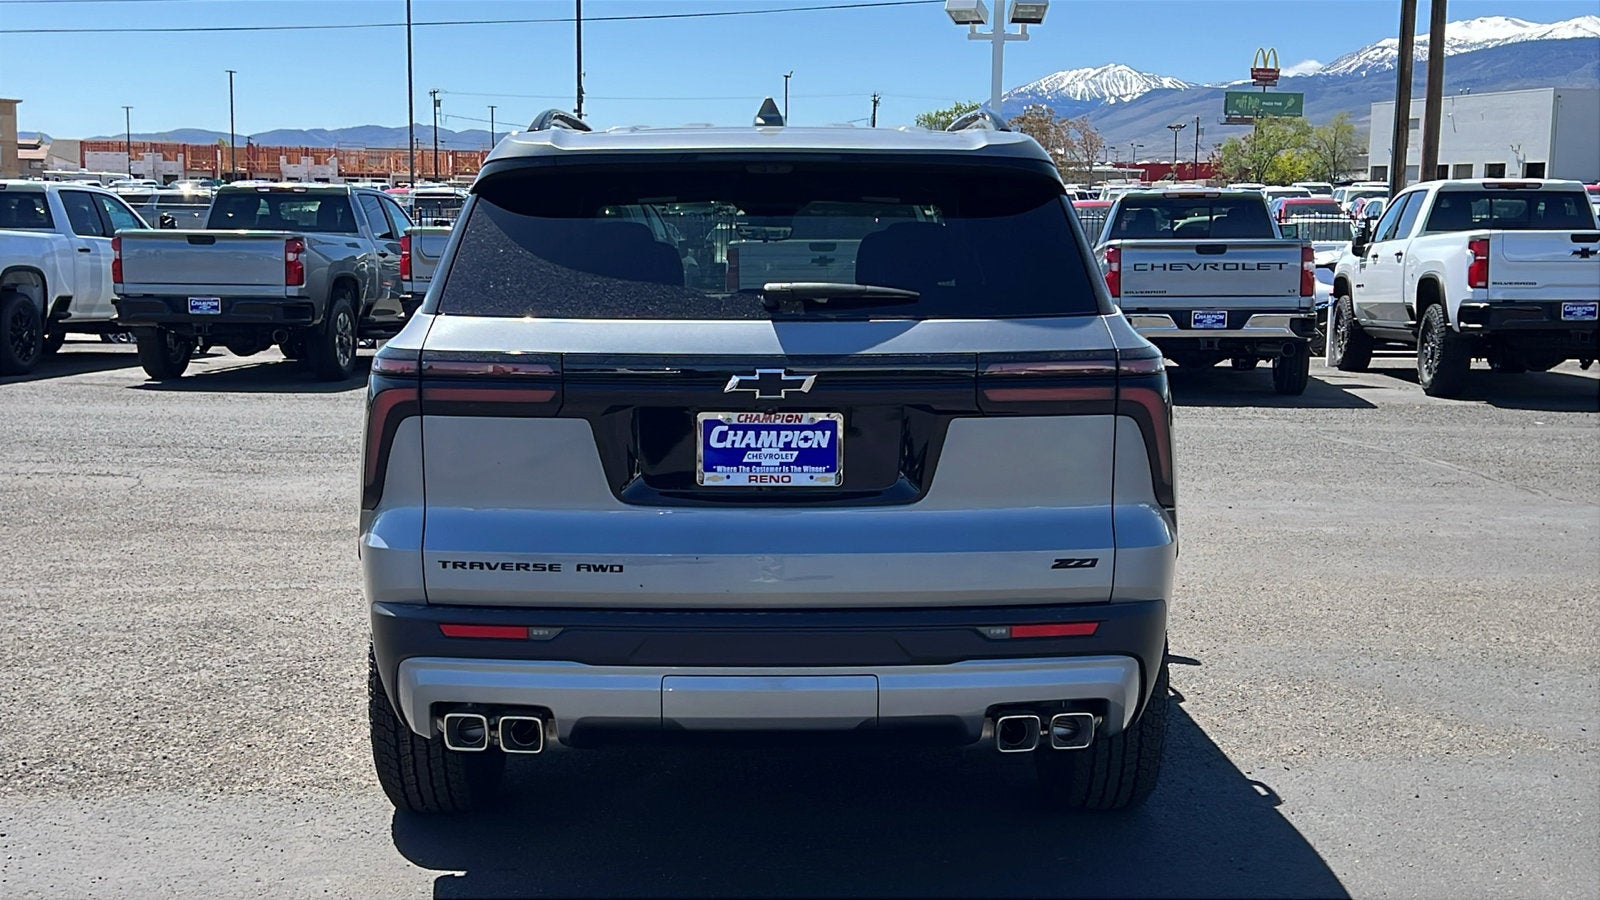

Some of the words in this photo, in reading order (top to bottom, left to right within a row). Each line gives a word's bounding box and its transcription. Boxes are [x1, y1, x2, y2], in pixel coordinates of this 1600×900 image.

[1133, 262, 1289, 272] CHEVROLET
[737, 413, 803, 423] CHAMPION
[709, 425, 831, 449] CHAMPION
[738, 465, 749, 473] The
[751, 465, 781, 473] Customer
[790, 465, 802, 473] The
[748, 474, 792, 484] RENO
[438, 560, 562, 572] TRAVERSE
[576, 563, 624, 573] AWD
[1051, 558, 1099, 569] Z71
